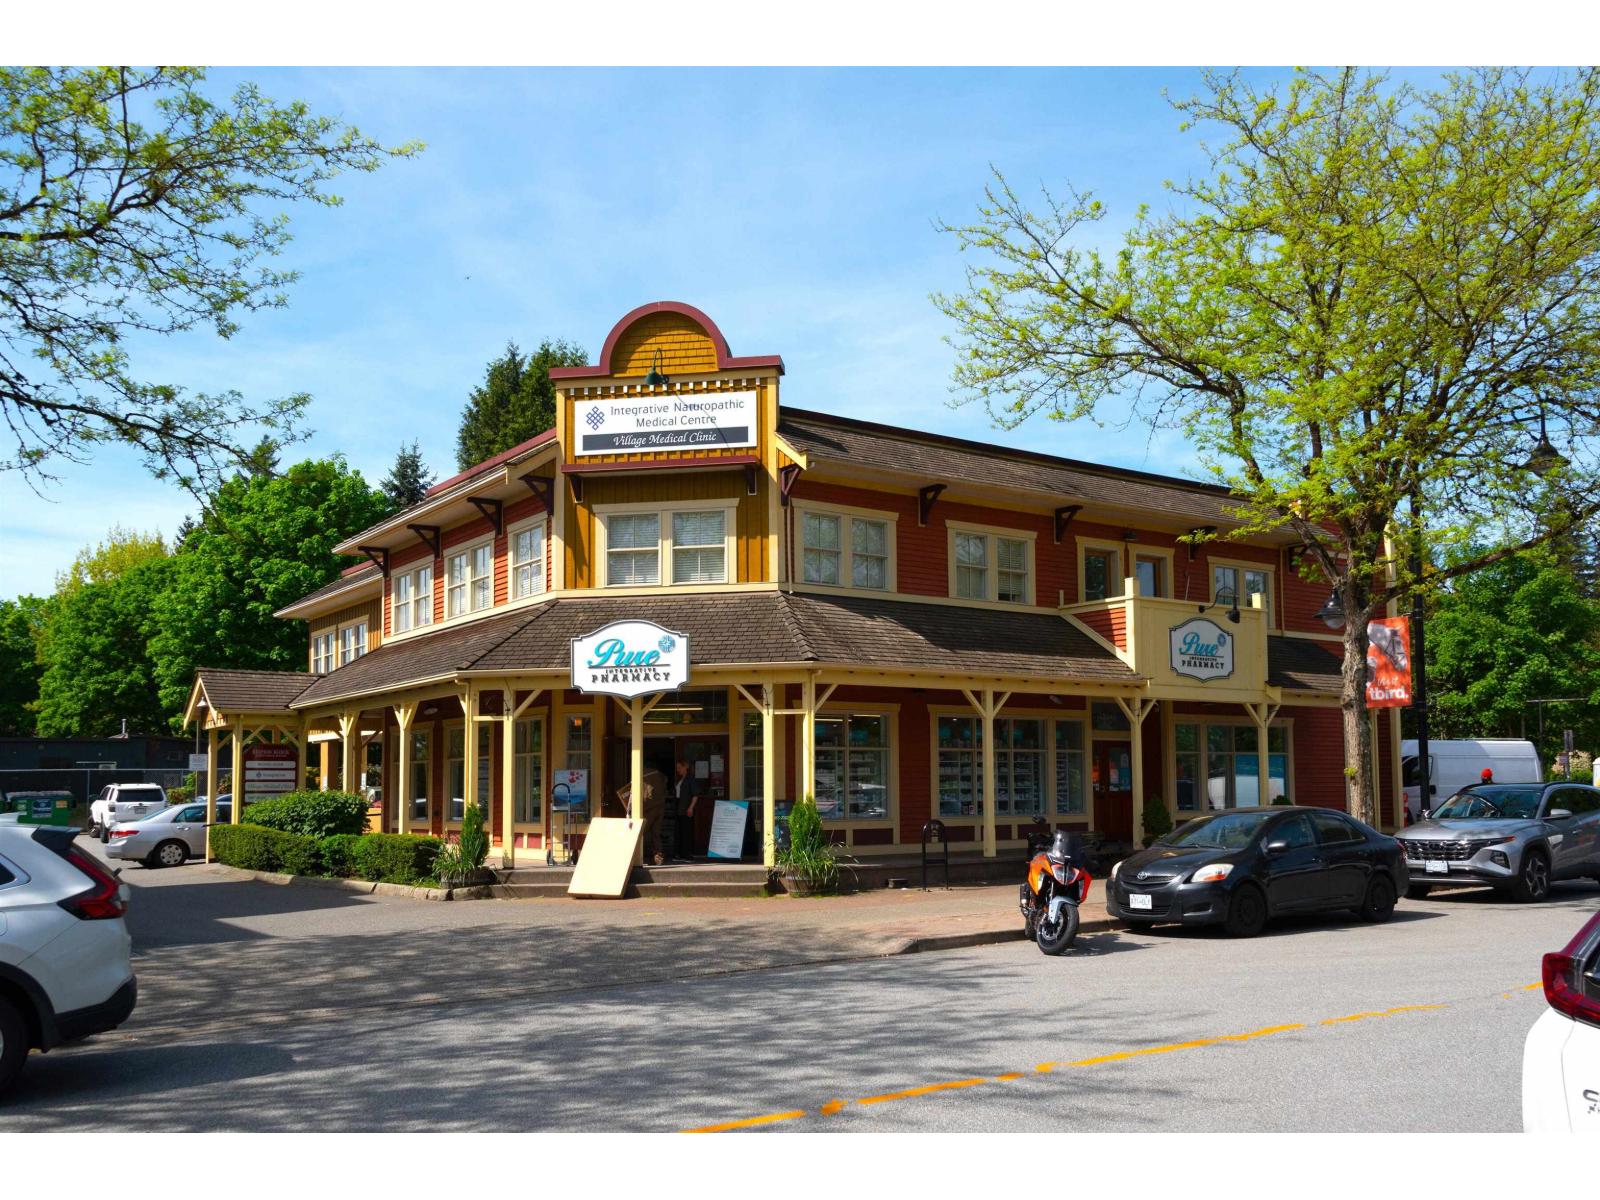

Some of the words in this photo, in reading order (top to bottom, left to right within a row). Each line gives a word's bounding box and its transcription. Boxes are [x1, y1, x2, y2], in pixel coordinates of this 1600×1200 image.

[610, 404, 669, 417] Integrative
[674, 399, 745, 412] Naturopathic
[636, 416, 677, 427] Medical
[680, 415, 717, 425] Centre
[613, 434, 647, 448] Village
[649, 431, 688, 445] Medical
[689, 431, 717, 443] Clinic
[587, 638, 661, 668] Pure
[1182, 660, 1225, 669] PHARMACY
[591, 672, 671, 684] PHARMACY
